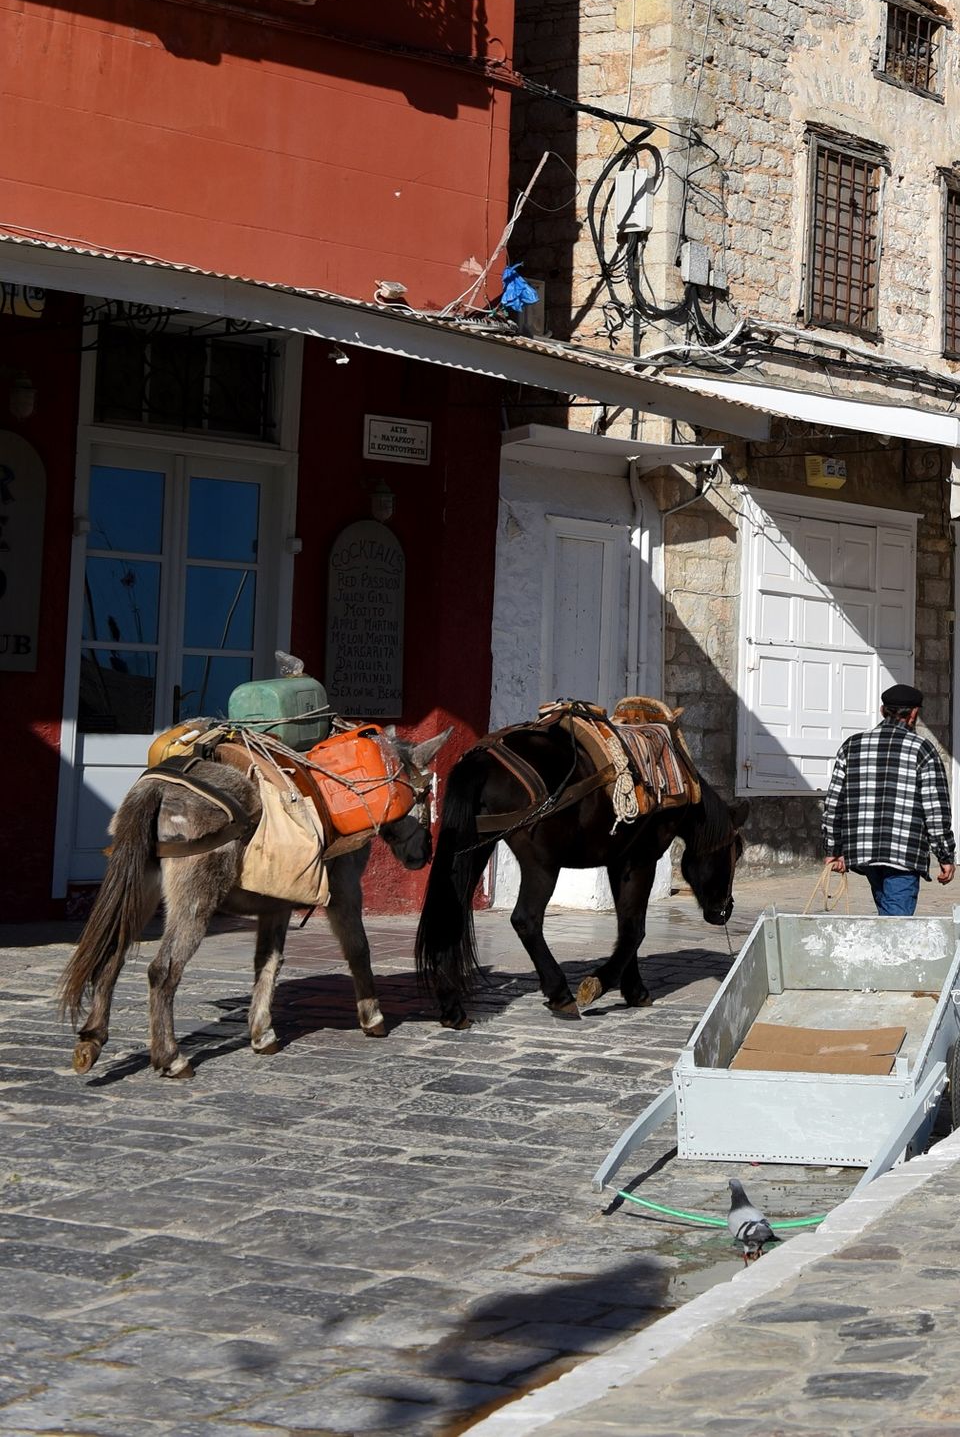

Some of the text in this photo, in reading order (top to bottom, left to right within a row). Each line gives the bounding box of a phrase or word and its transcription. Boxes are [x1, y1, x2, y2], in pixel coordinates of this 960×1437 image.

[390, 426, 408, 434] ΑΚΤΗ
[381, 434, 416, 445] ΝΑΥΑΡΧΟΥ
[331, 540, 404, 572] COCKTAILS
[337, 572, 400, 590] RED PASSION
[344, 603, 385, 617] MOJITO
[330, 617, 398, 631] APPLE MARTINI
[330, 631, 398, 646] MELON MARTINI
[336, 644, 394, 659] MARGARITA
[335, 656, 389, 670] DAIQUIRI
[333, 670, 392, 684] CAIPIRINHA
[330, 682, 352, 697] SEX
